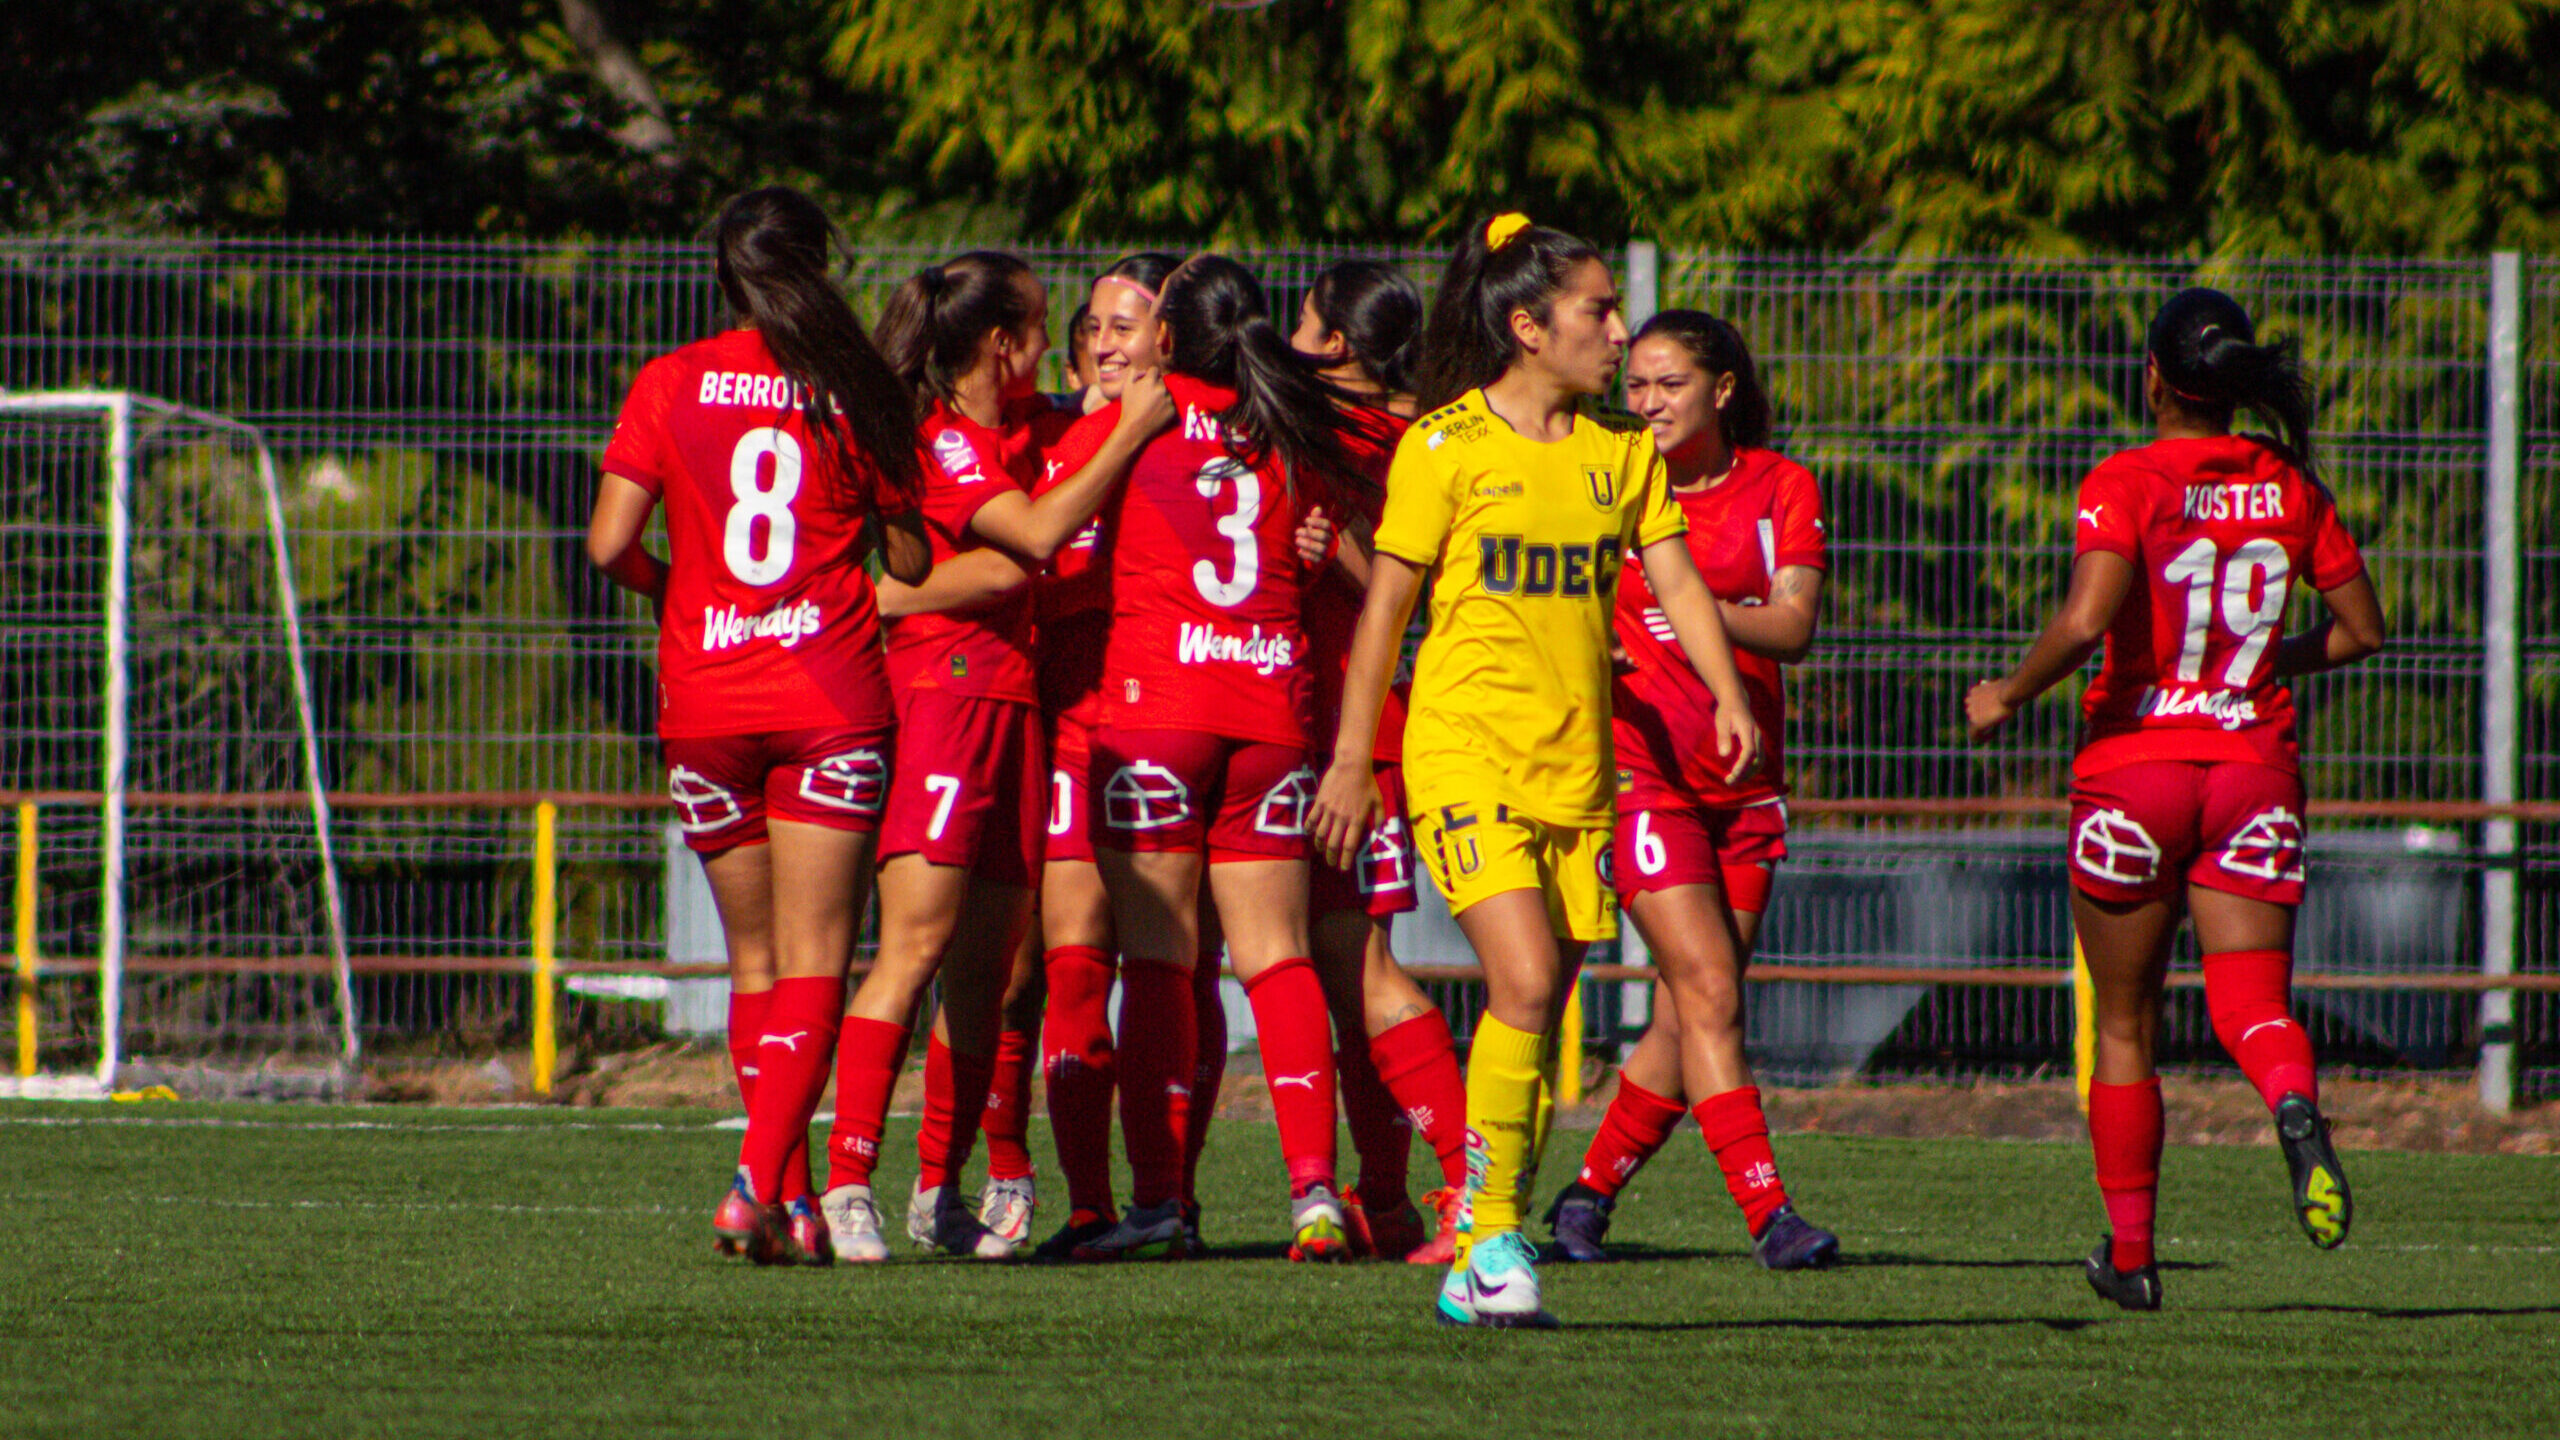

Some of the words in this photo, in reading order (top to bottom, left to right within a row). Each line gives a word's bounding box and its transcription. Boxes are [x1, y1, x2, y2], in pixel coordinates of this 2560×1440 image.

[723, 426, 802, 586] 8
[1192, 456, 1260, 608] 3
[2184, 482, 2284, 520] KOSTER
[702, 597, 820, 651] Wendy's
[2164, 537, 2291, 688] 19
[1178, 621, 1292, 675] Wendy's
[2136, 684, 2257, 731] Wendy's
[925, 774, 960, 841] 7
[1635, 809, 1667, 876] 6
